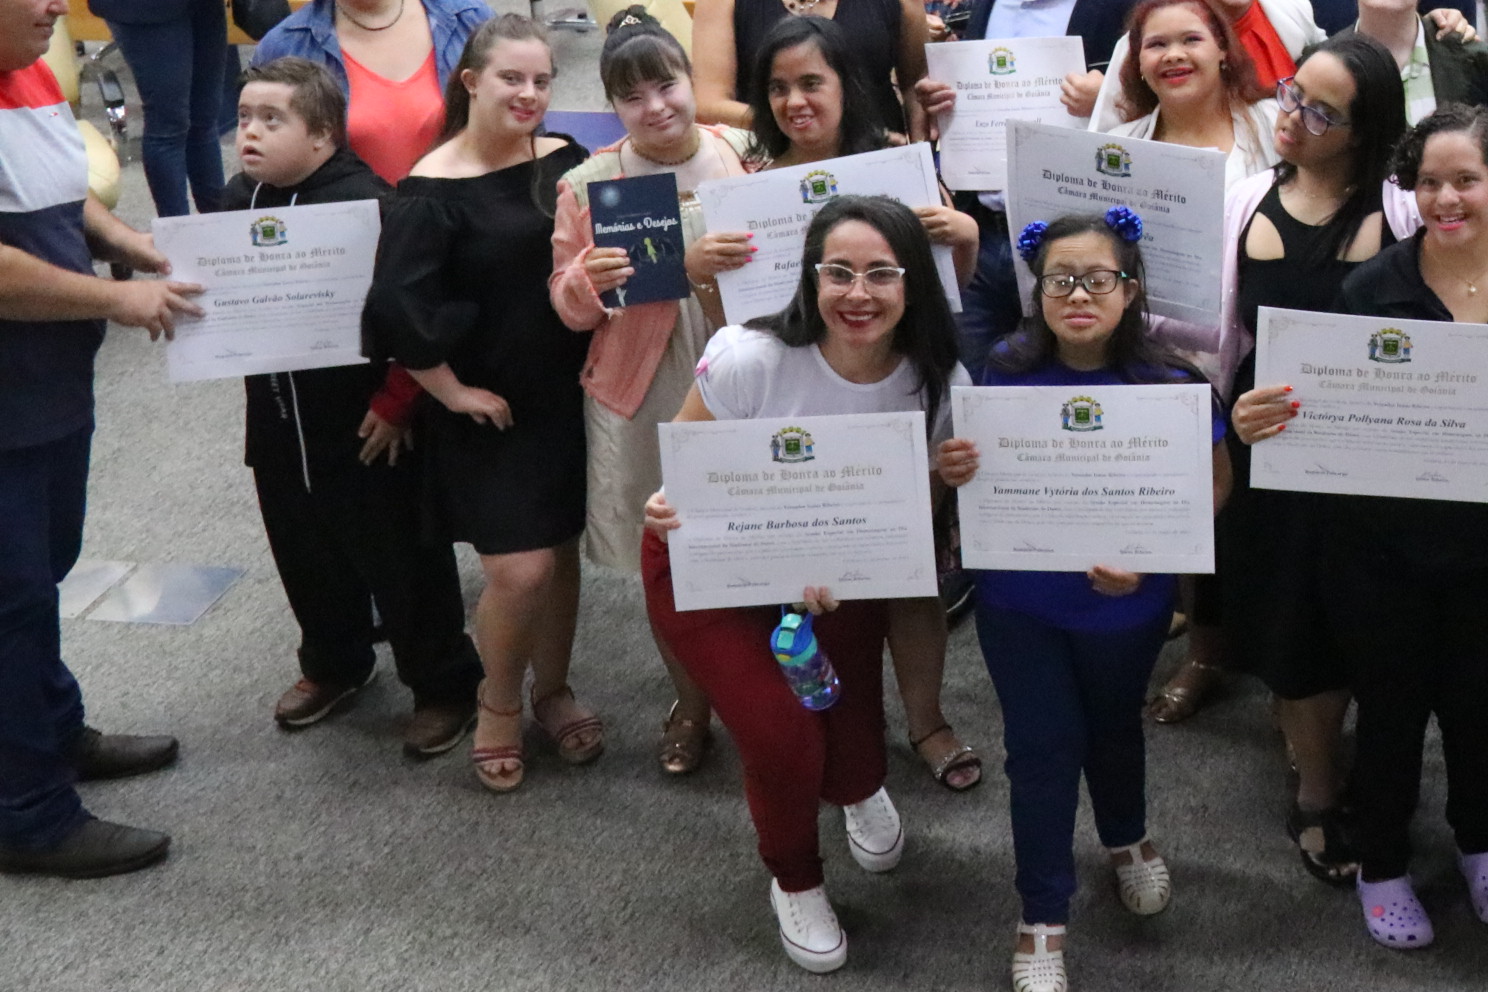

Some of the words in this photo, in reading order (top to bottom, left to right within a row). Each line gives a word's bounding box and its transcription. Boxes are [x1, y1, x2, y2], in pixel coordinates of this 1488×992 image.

[956, 81, 982, 90] Diploma
[984, 80, 991, 88] de
[994, 79, 1019, 88] Honra
[1034, 76, 1062, 87] Mérito
[1042, 169, 1084, 186] Diploma
[1087, 177, 1098, 188] de
[1101, 179, 1132, 194] Honra
[1137, 187, 1148, 196] ao
[1152, 189, 1186, 204] Mérito
[1058, 186, 1087, 199] Câmara
[1089, 192, 1127, 206] Municipal
[1139, 200, 1170, 214] Goiânia
[595, 222, 635, 234] Memórias
[643, 216, 678, 232] Desejos
[747, 217, 793, 230] Diploma
[796, 213, 807, 222] de
[766, 228, 799, 240] Câmara
[197, 256, 241, 267] Diploma
[244, 254, 255, 263] de
[258, 252, 292, 262] Honra
[310, 247, 346, 258] Mérito
[214, 299, 249, 307] Gustavo
[252, 295, 283, 305] Galvão
[1301, 363, 1353, 378] Diploma
[1356, 367, 1369, 378] de
[1374, 367, 1413, 381] Honra
[1417, 373, 1430, 382] ao
[1435, 370, 1477, 384] Mérito
[1318, 380, 1354, 391] Câmara
[1357, 382, 1404, 393] Municipal
[1407, 384, 1417, 393] de
[1419, 384, 1456, 396] Goiânia
[1302, 411, 1344, 423] Victórya
[1348, 414, 1393, 426] Pollyana
[1396, 417, 1421, 427] Rosa
[1425, 417, 1437, 427] da
[1439, 419, 1466, 428] Silva
[997, 437, 1048, 449] Diploma
[1051, 437, 1064, 448] de
[1068, 437, 1106, 448] Honra
[1110, 439, 1123, 448] ao
[1127, 436, 1169, 449] Mérito
[1016, 453, 1051, 462] Câmara
[1054, 453, 1099, 463] Municipal
[1102, 453, 1112, 462] de
[1114, 453, 1150, 462] Goiânia
[706, 472, 759, 484] Diploma
[762, 470, 775, 481] de
[779, 468, 820, 481] Honra
[823, 470, 836, 478] ao
[840, 465, 883, 478] Mérito
[727, 485, 763, 496] Câmara
[766, 483, 812, 495] Municipal
[815, 482, 825, 493] de
[827, 482, 864, 492] Goiânia
[993, 486, 1040, 496] Yammane
[1044, 486, 1079, 498] Vytória
[1082, 486, 1099, 496] dos
[1101, 486, 1135, 496] Santos
[1138, 486, 1176, 496] Ribeiro
[727, 521, 763, 532] Rejane
[766, 519, 809, 530] Barbosa
[811, 517, 829, 528] dos
[832, 516, 867, 526] Santos
